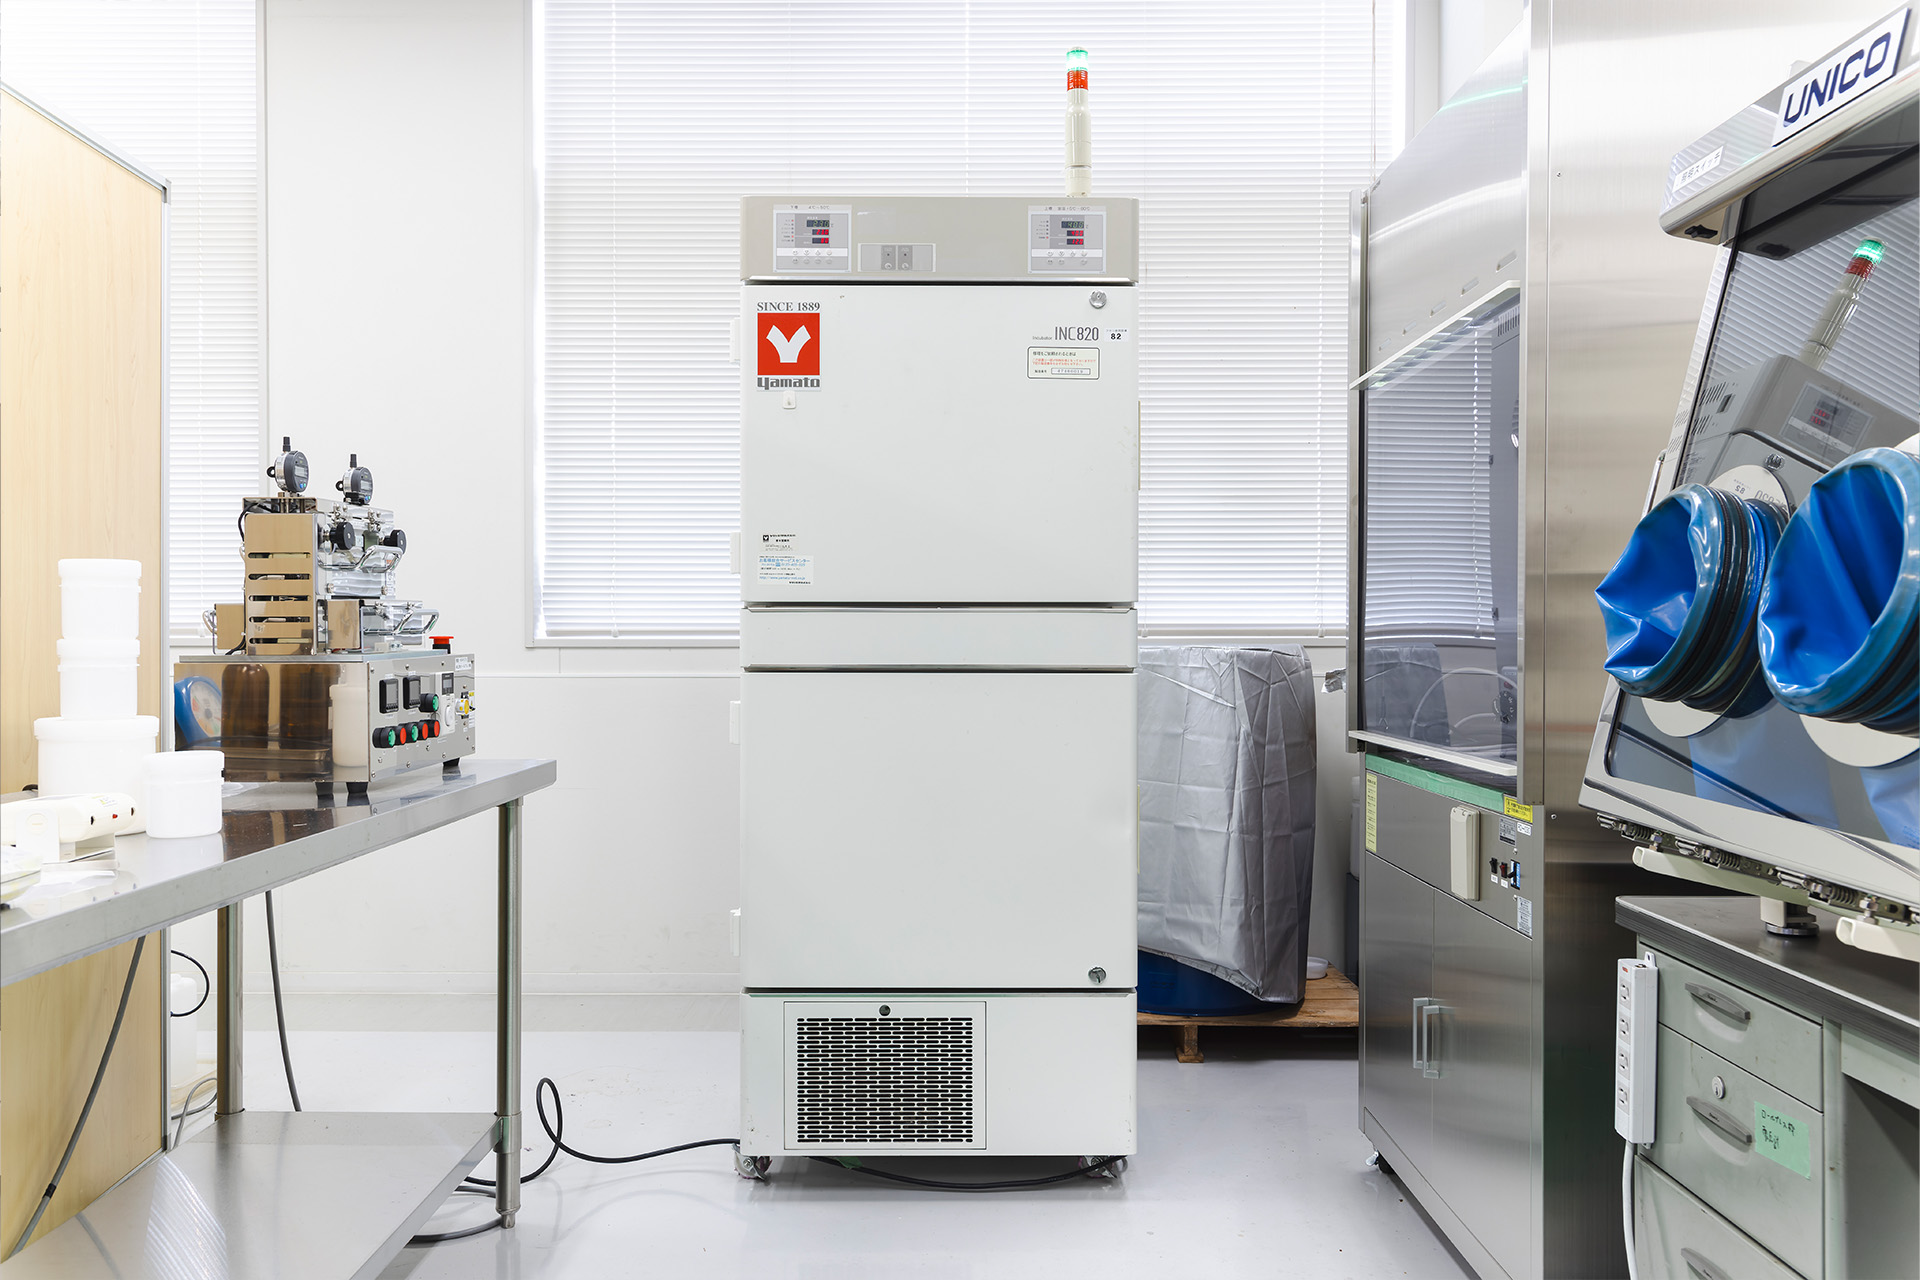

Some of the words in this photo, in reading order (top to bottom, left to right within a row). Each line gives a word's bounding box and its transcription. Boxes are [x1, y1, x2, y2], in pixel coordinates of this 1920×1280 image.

[1783, 31, 1891, 128] UNICO
[757, 302, 793, 311] SINCE
[797, 302, 820, 311] 1889
[1054, 326, 1099, 341] INC820
